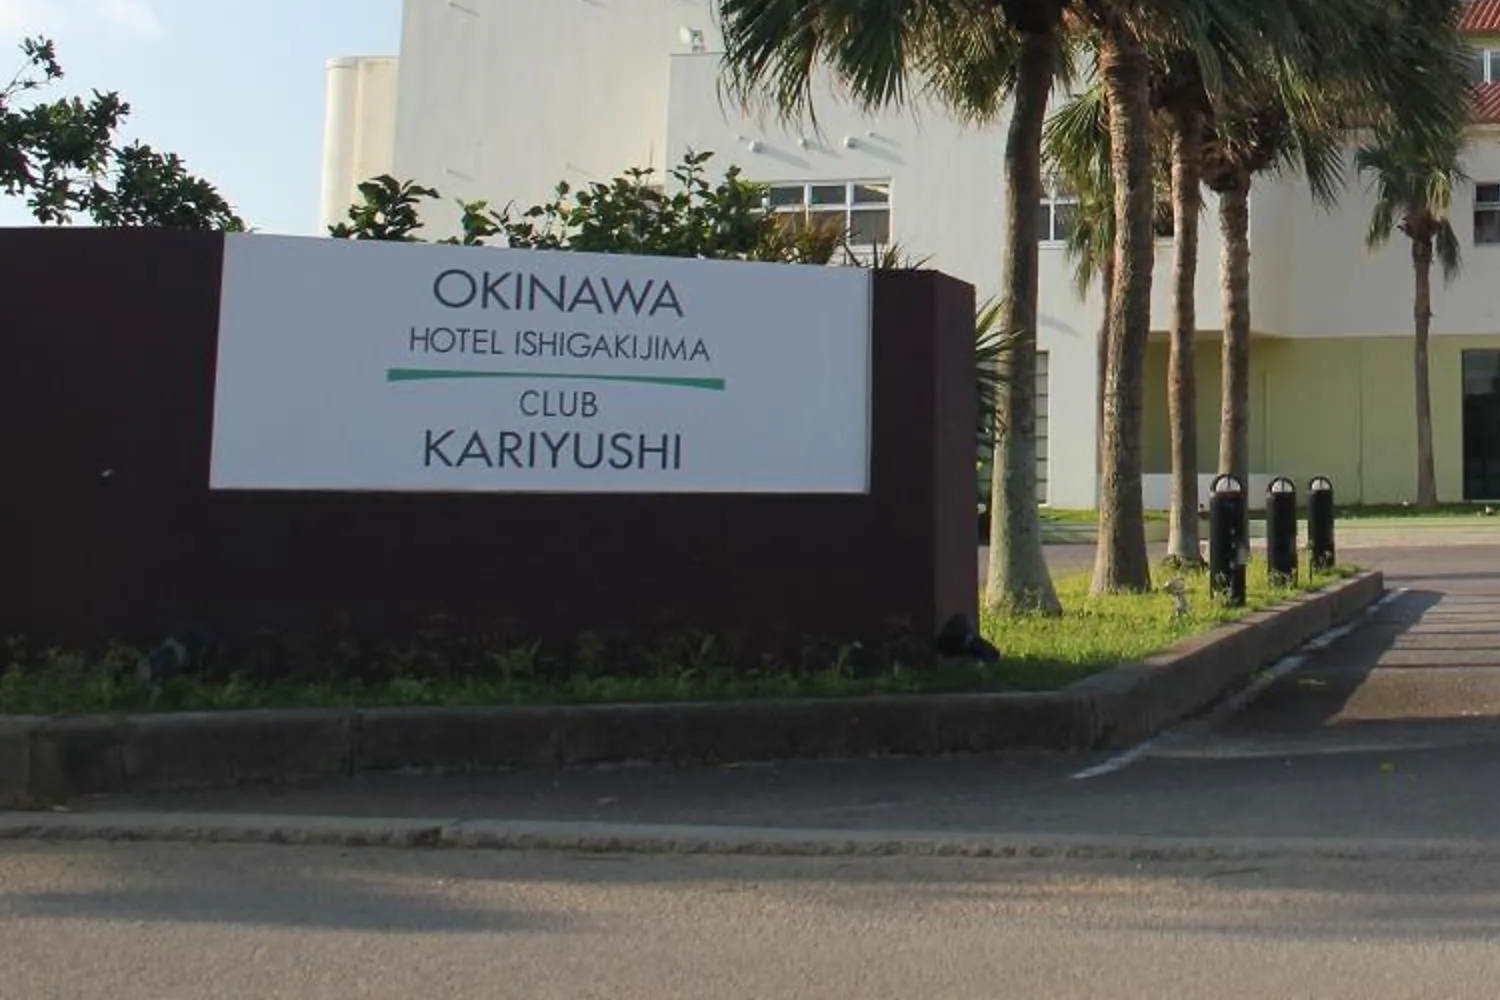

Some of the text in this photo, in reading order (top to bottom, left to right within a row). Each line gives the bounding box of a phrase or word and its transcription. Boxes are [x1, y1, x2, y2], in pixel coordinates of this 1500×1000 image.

[432, 268, 684, 318] OKINAWA
[409, 326, 711, 362] HOTEL ISHIGAKIJIMA
[518, 389, 599, 418] CLUB
[422, 428, 682, 471] KARIYUSHI
